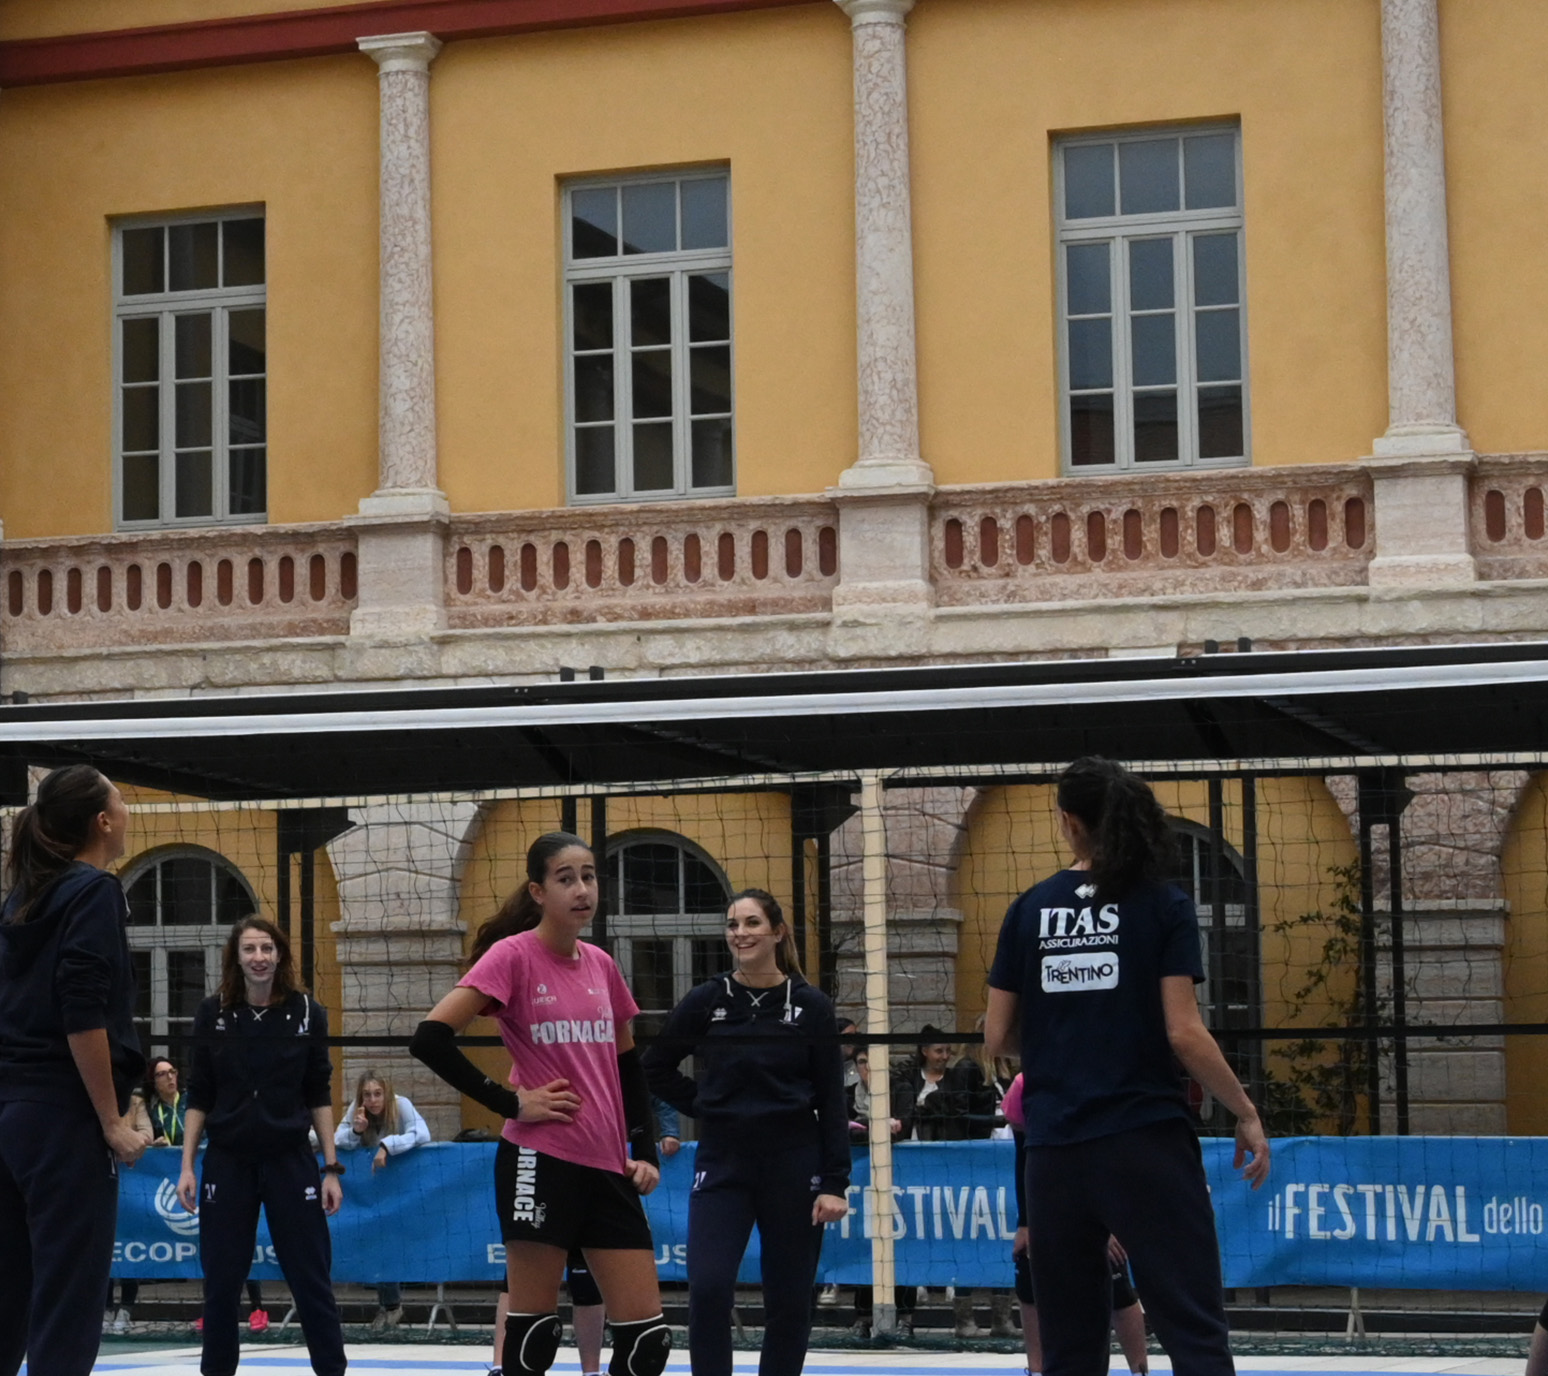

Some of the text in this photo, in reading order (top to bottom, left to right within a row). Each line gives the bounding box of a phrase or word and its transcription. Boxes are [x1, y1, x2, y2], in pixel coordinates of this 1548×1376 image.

[1038, 903, 1120, 938] ITAS
[1038, 934, 1120, 950] ASSICURAZIONI
[1045, 963, 1114, 984] TRENTINO
[1268, 1193, 1280, 1231] il
[1285, 1184, 1480, 1242] FESTIVAL
[1483, 1196, 1544, 1235] dello
